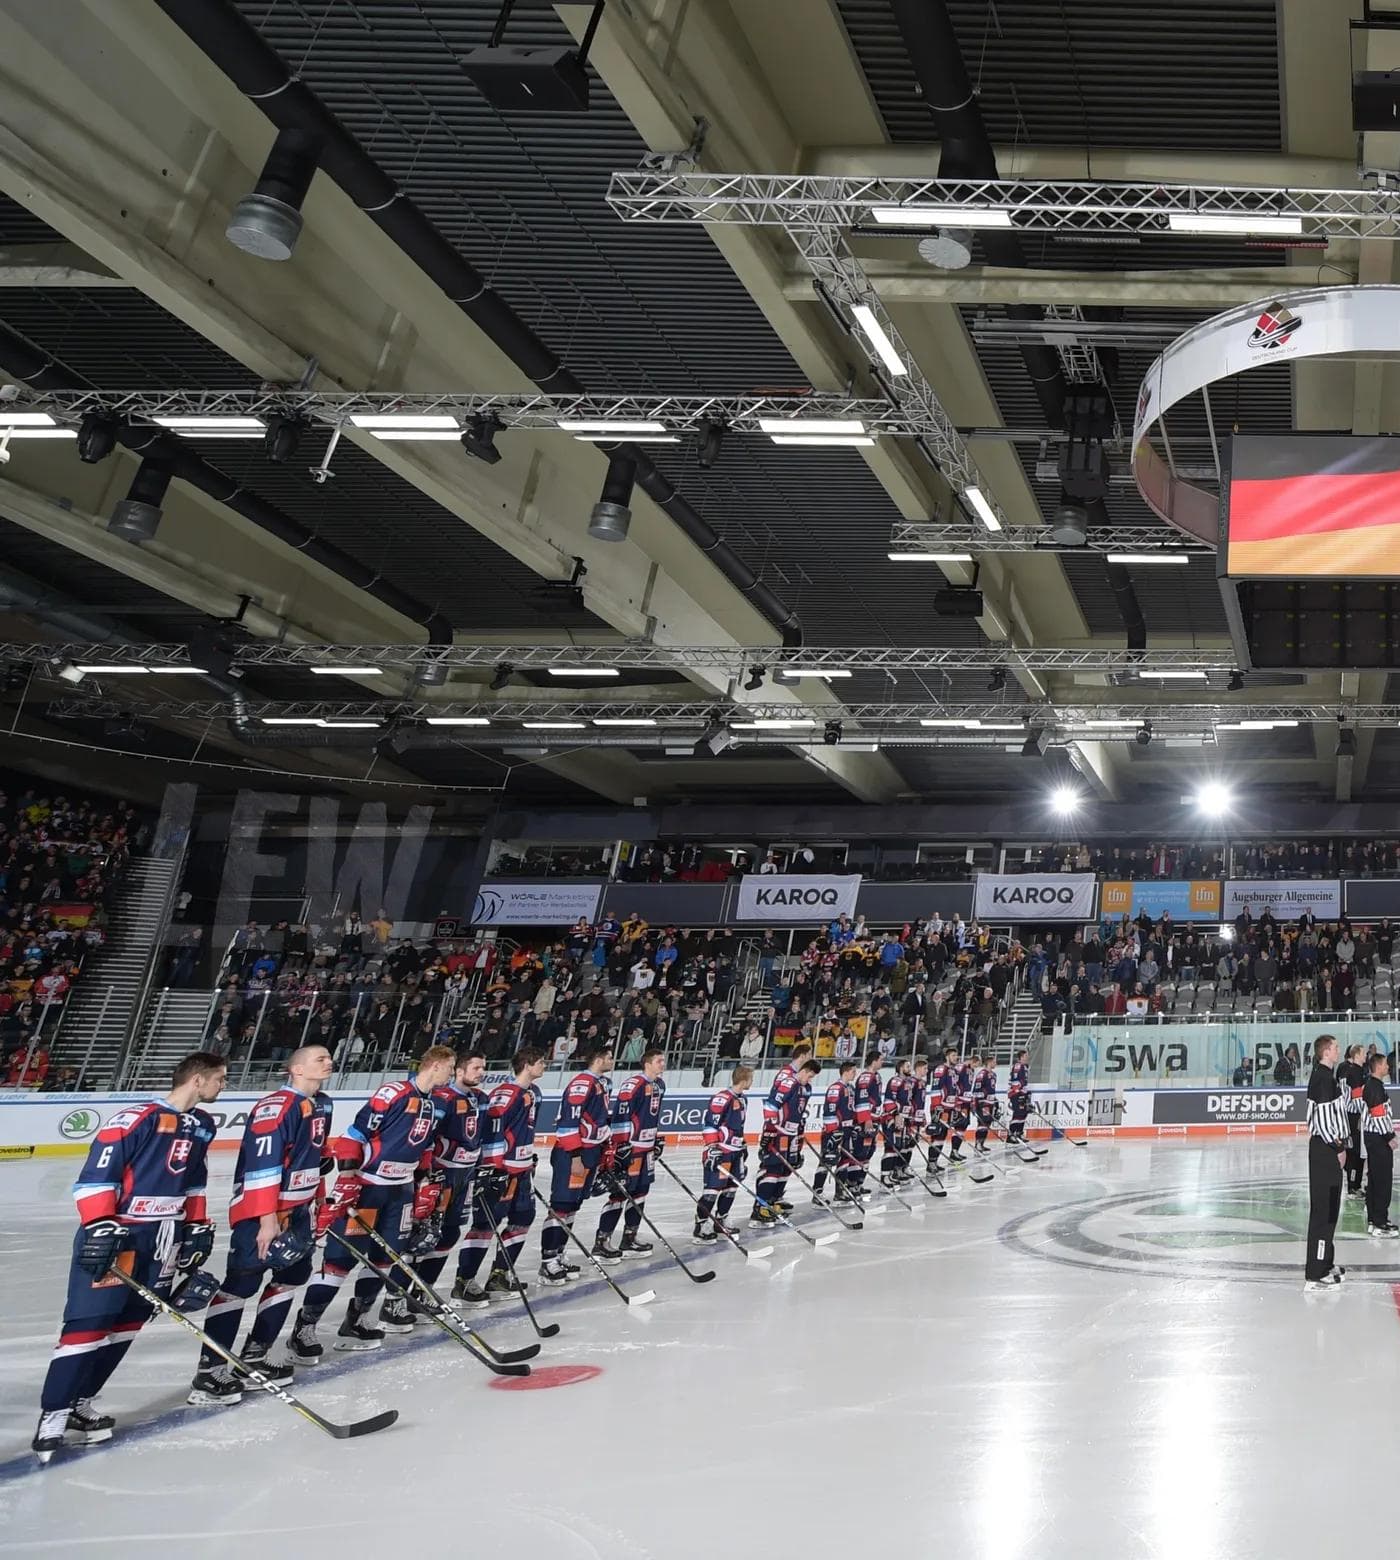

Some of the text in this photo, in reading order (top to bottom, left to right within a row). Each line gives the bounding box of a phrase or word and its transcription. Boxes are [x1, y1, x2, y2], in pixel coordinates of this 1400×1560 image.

[755, 887, 839, 905] KAROQ
[992, 886, 1074, 905] KAROQ
[1232, 890, 1334, 903] Augsburger Allgemeine
[1104, 1042, 1188, 1073] swa
[367, 1113, 384, 1131] 15
[571, 1106, 582, 1120] 14
[1216, 1112, 1286, 1121] WWW.DEF-SHOP.COM
[255, 1135, 272, 1157] 71
[97, 1146, 114, 1169] 6
[138, 1288, 161, 1309] CCM
[440, 1303, 471, 1332] CCM
[249, 1370, 297, 1404] CCM
